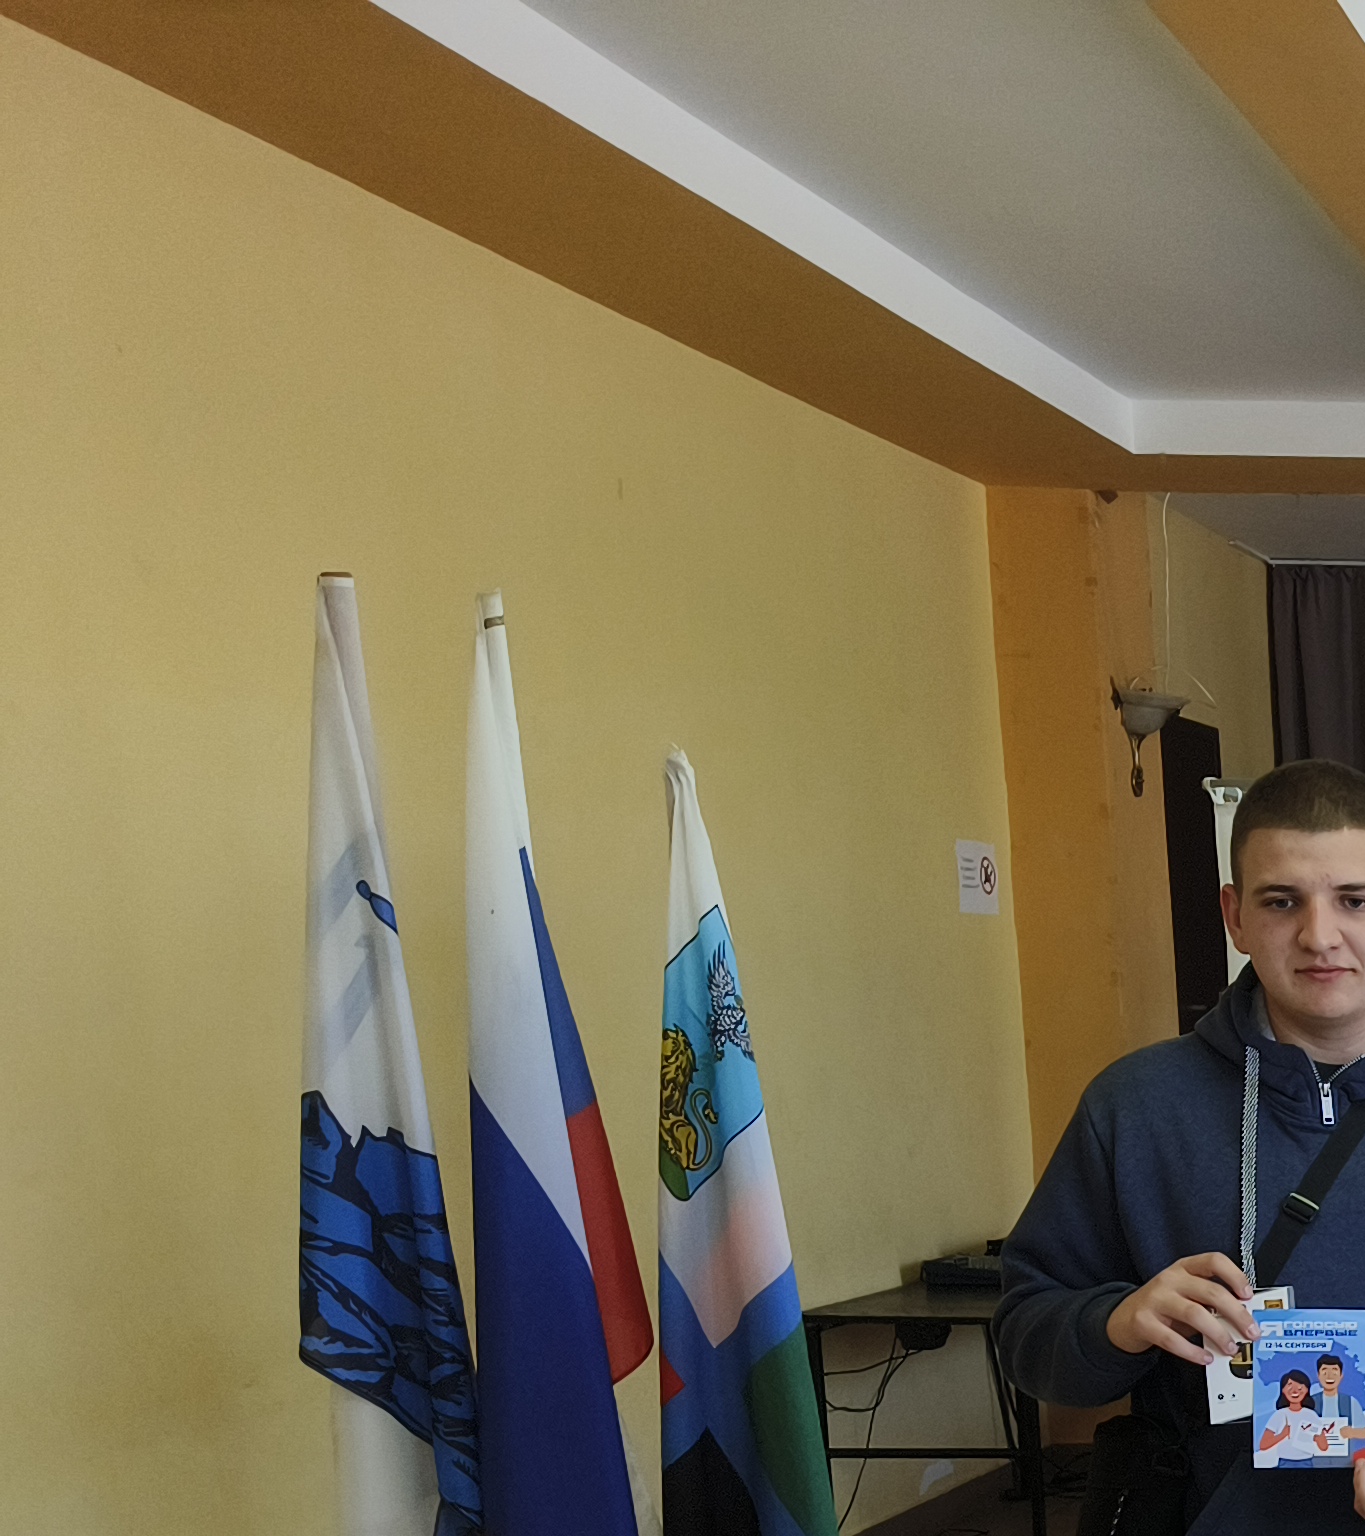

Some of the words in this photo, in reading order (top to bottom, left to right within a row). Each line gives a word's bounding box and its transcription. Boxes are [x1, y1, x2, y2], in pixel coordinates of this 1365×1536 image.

[1260, 1321, 1283, 1337] Я
[1284, 1321, 1358, 1329] ГОЛОСУЮ
[1284, 1329, 1358, 1337] ВПЕРВЫЕ
